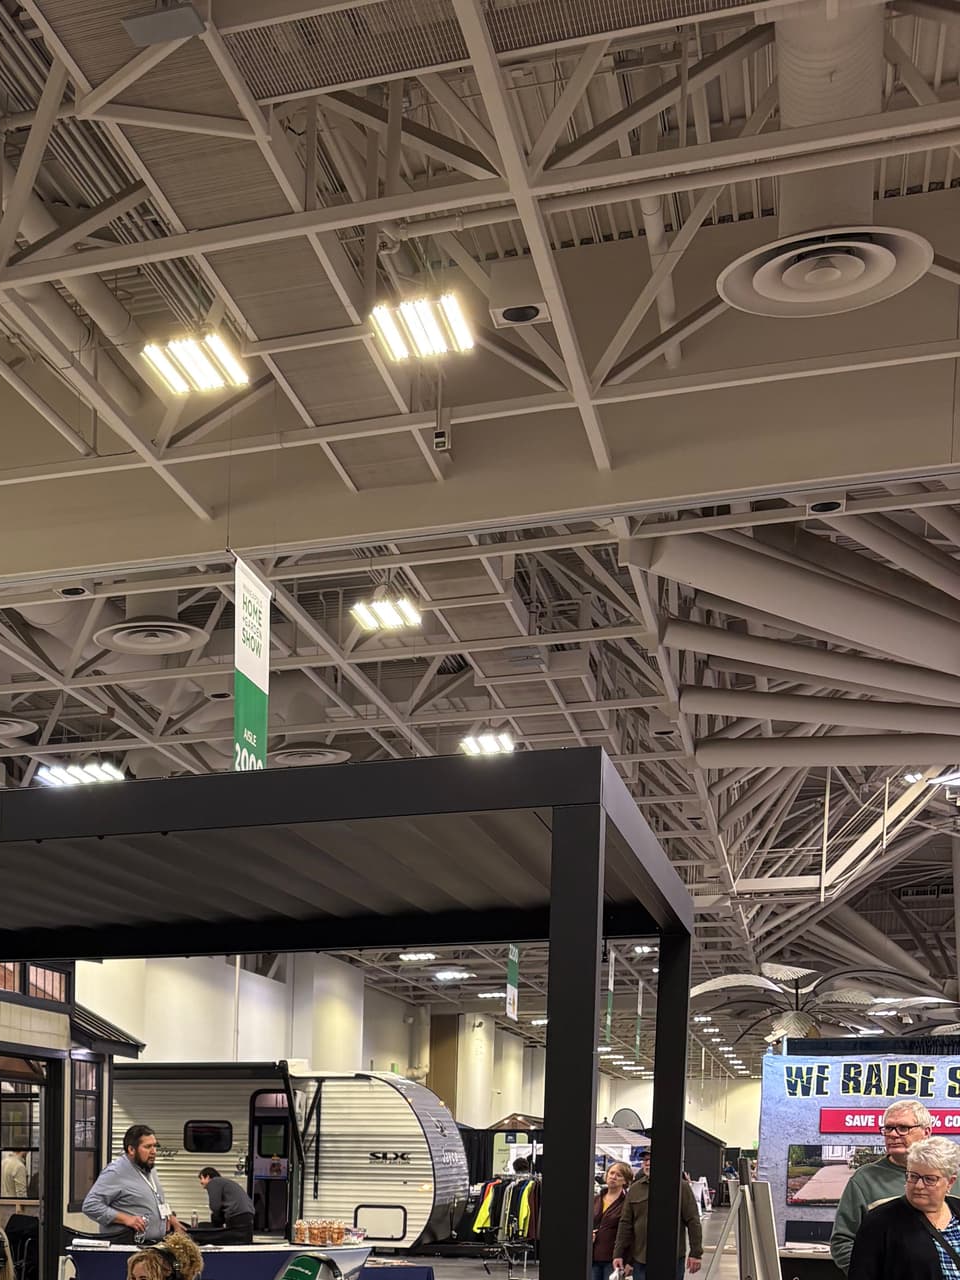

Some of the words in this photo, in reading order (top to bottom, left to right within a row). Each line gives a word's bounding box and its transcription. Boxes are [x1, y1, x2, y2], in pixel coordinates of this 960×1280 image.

[243, 593, 262, 627] HOME
[242, 627, 262, 658] SHOW
[785, 1064, 831, 1098] WE
[841, 1062, 936, 1098] RAISE
[845, 1115, 875, 1126] SAVE
